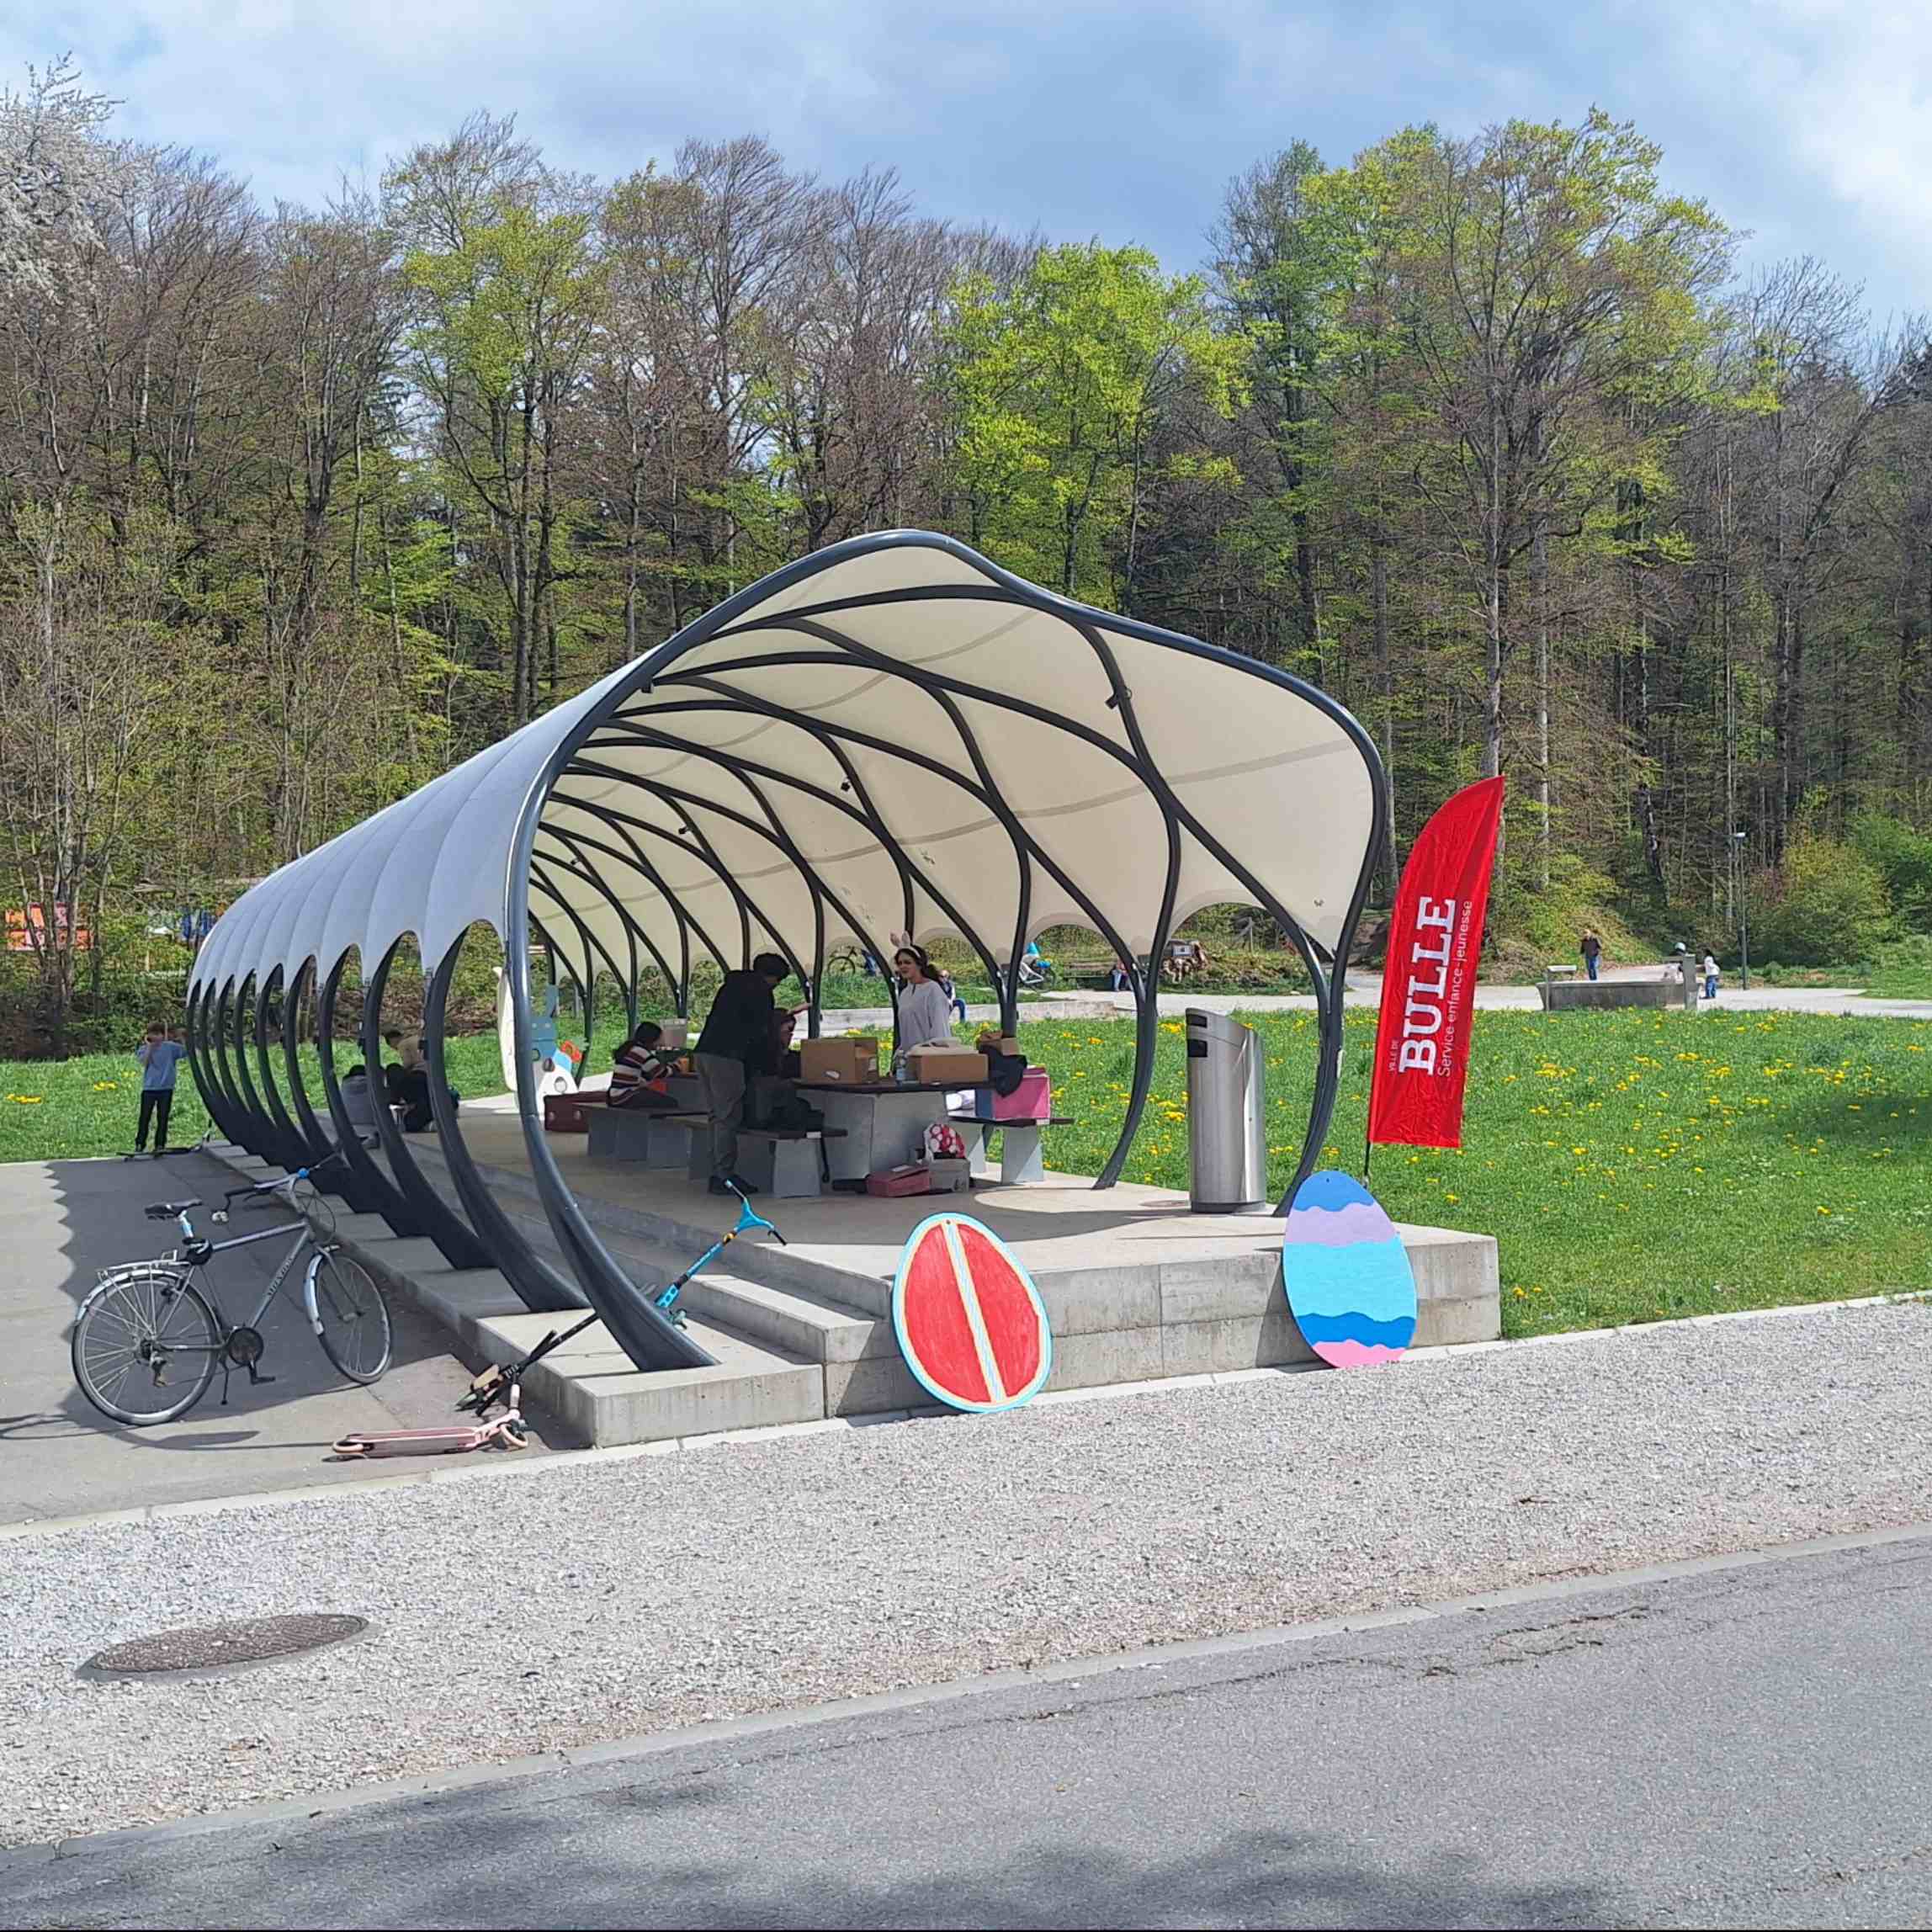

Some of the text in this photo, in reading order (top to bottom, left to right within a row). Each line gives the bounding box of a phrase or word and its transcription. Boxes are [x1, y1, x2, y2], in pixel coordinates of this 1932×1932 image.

[1399, 896, 1456, 1076] BULLE
[1437, 901, 1473, 1077] Service enfance-jeunesse
